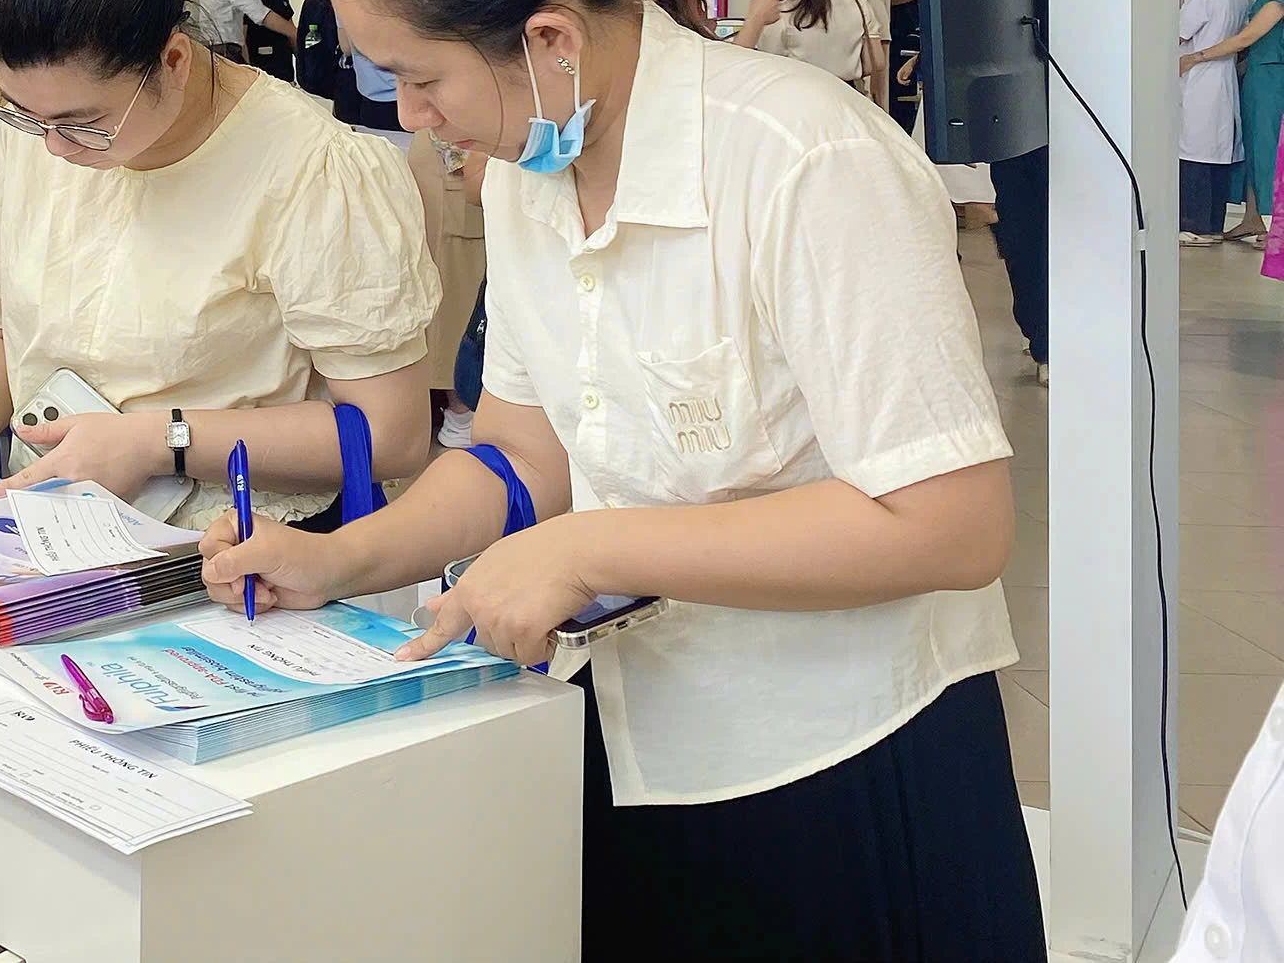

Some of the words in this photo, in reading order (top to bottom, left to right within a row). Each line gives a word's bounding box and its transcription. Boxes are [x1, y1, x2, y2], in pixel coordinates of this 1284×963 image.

[69, 739, 102, 756] PHIẾU
[101, 751, 139, 772] THÔNG
[137, 767, 159, 780] TIN
